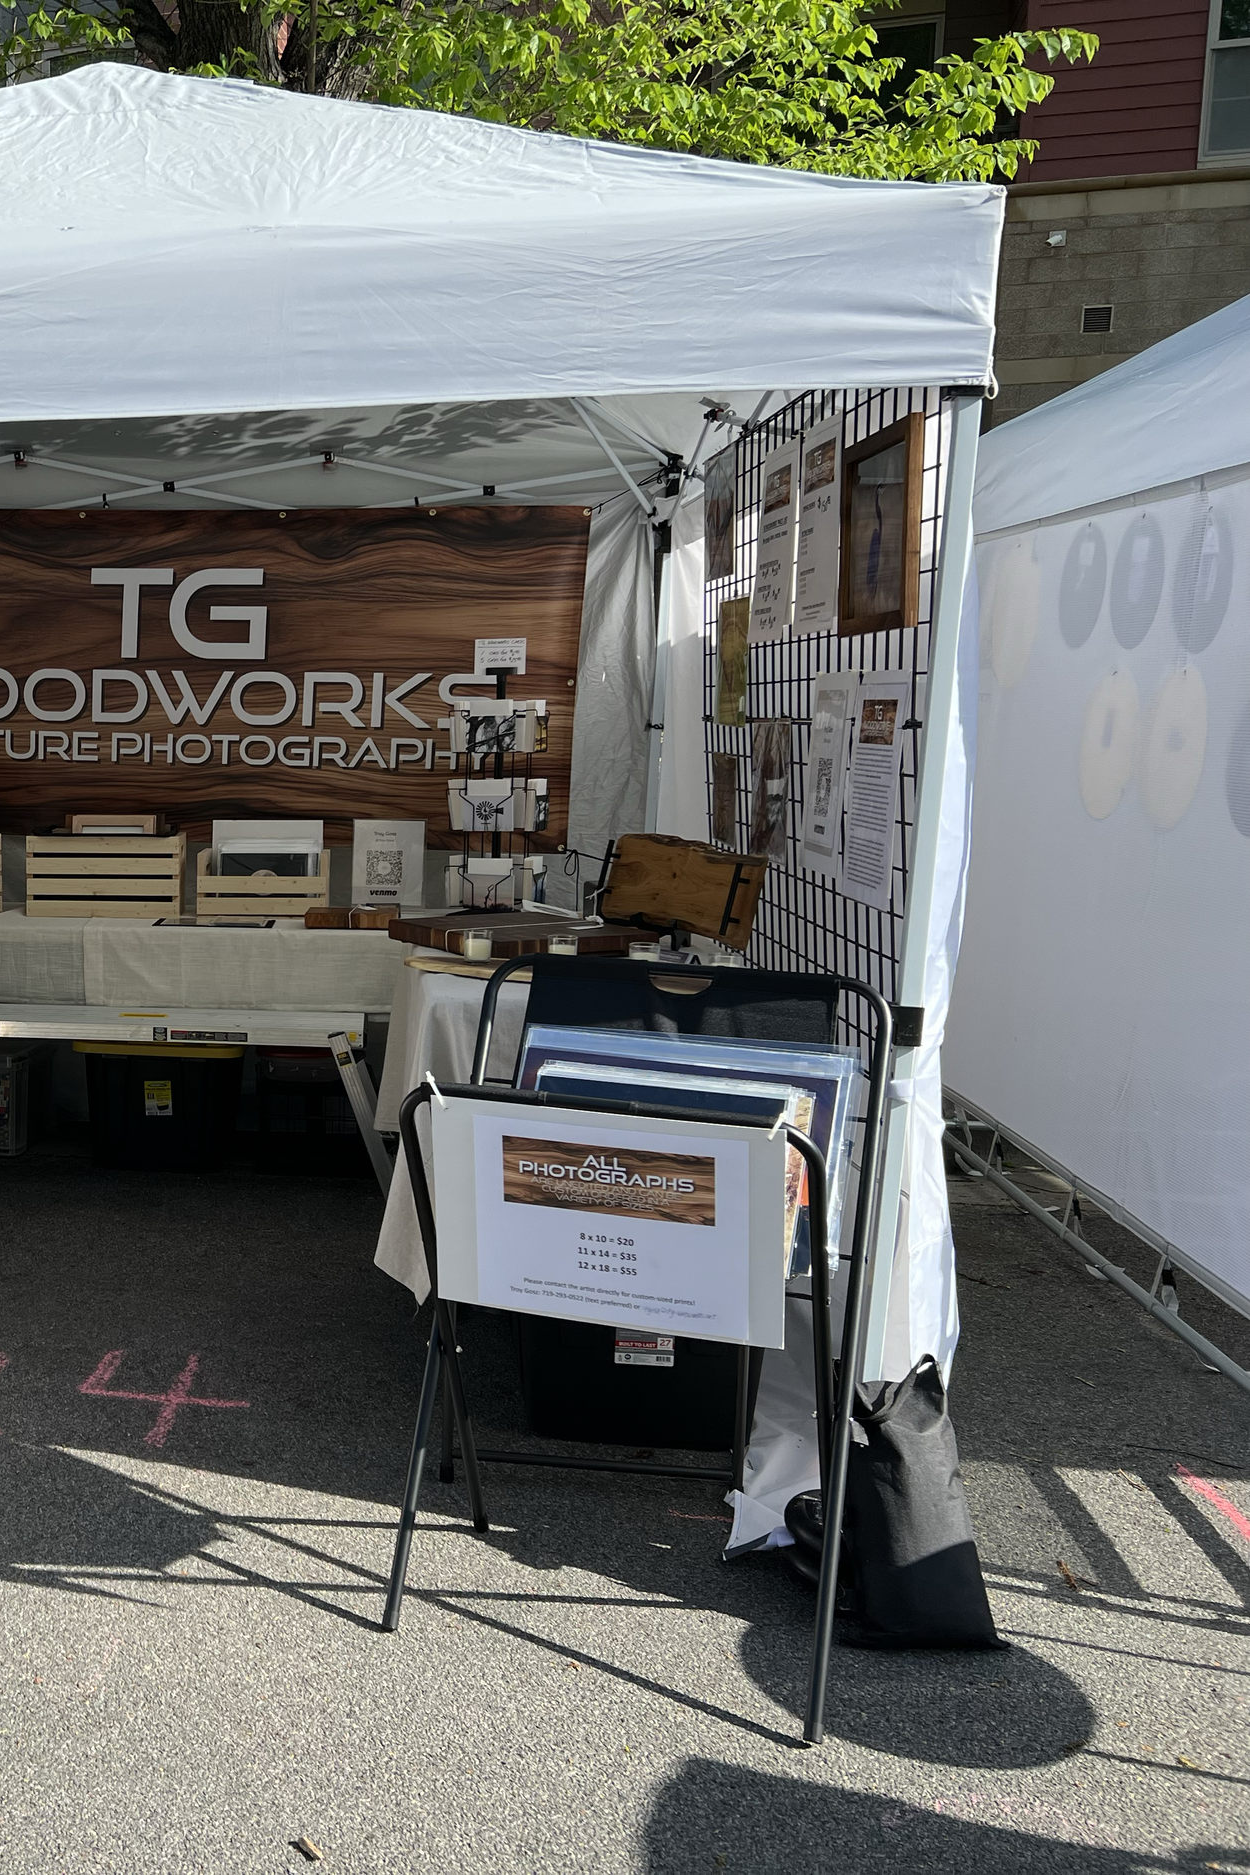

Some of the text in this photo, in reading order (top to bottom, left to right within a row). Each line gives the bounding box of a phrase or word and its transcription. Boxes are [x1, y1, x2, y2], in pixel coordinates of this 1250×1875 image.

[90, 568, 267, 660] TG
[583, 1155, 626, 1172] ALL
[518, 1160, 695, 1193] PHOTOGRAPHS
[531, 1176, 556, 1185] ARE
[557, 1179, 609, 1192] UNEDITED
[609, 1186, 637, 1195] AND
[639, 1189, 666, 1199] CAN
[541, 1184, 589, 1197] CUSTOM
[591, 1189, 647, 1204] ORDERED
[554, 1193, 655, 1212] VARIETY OF SIZES
[596, 1235, 607, 1243] 10
[617, 1236, 634, 1247] $20
[578, 1247, 588, 1255] 11
[599, 1250, 610, 1258] 14
[620, 1251, 637, 1262] $35
[578, 1261, 589, 1270] 12
[599, 1264, 610, 1273] 18
[620, 1266, 637, 1276] $55
[524, 1277, 696, 1306] Please contact the artist directly for custom-sized prints!
[659, 1339, 671, 1347] 27
